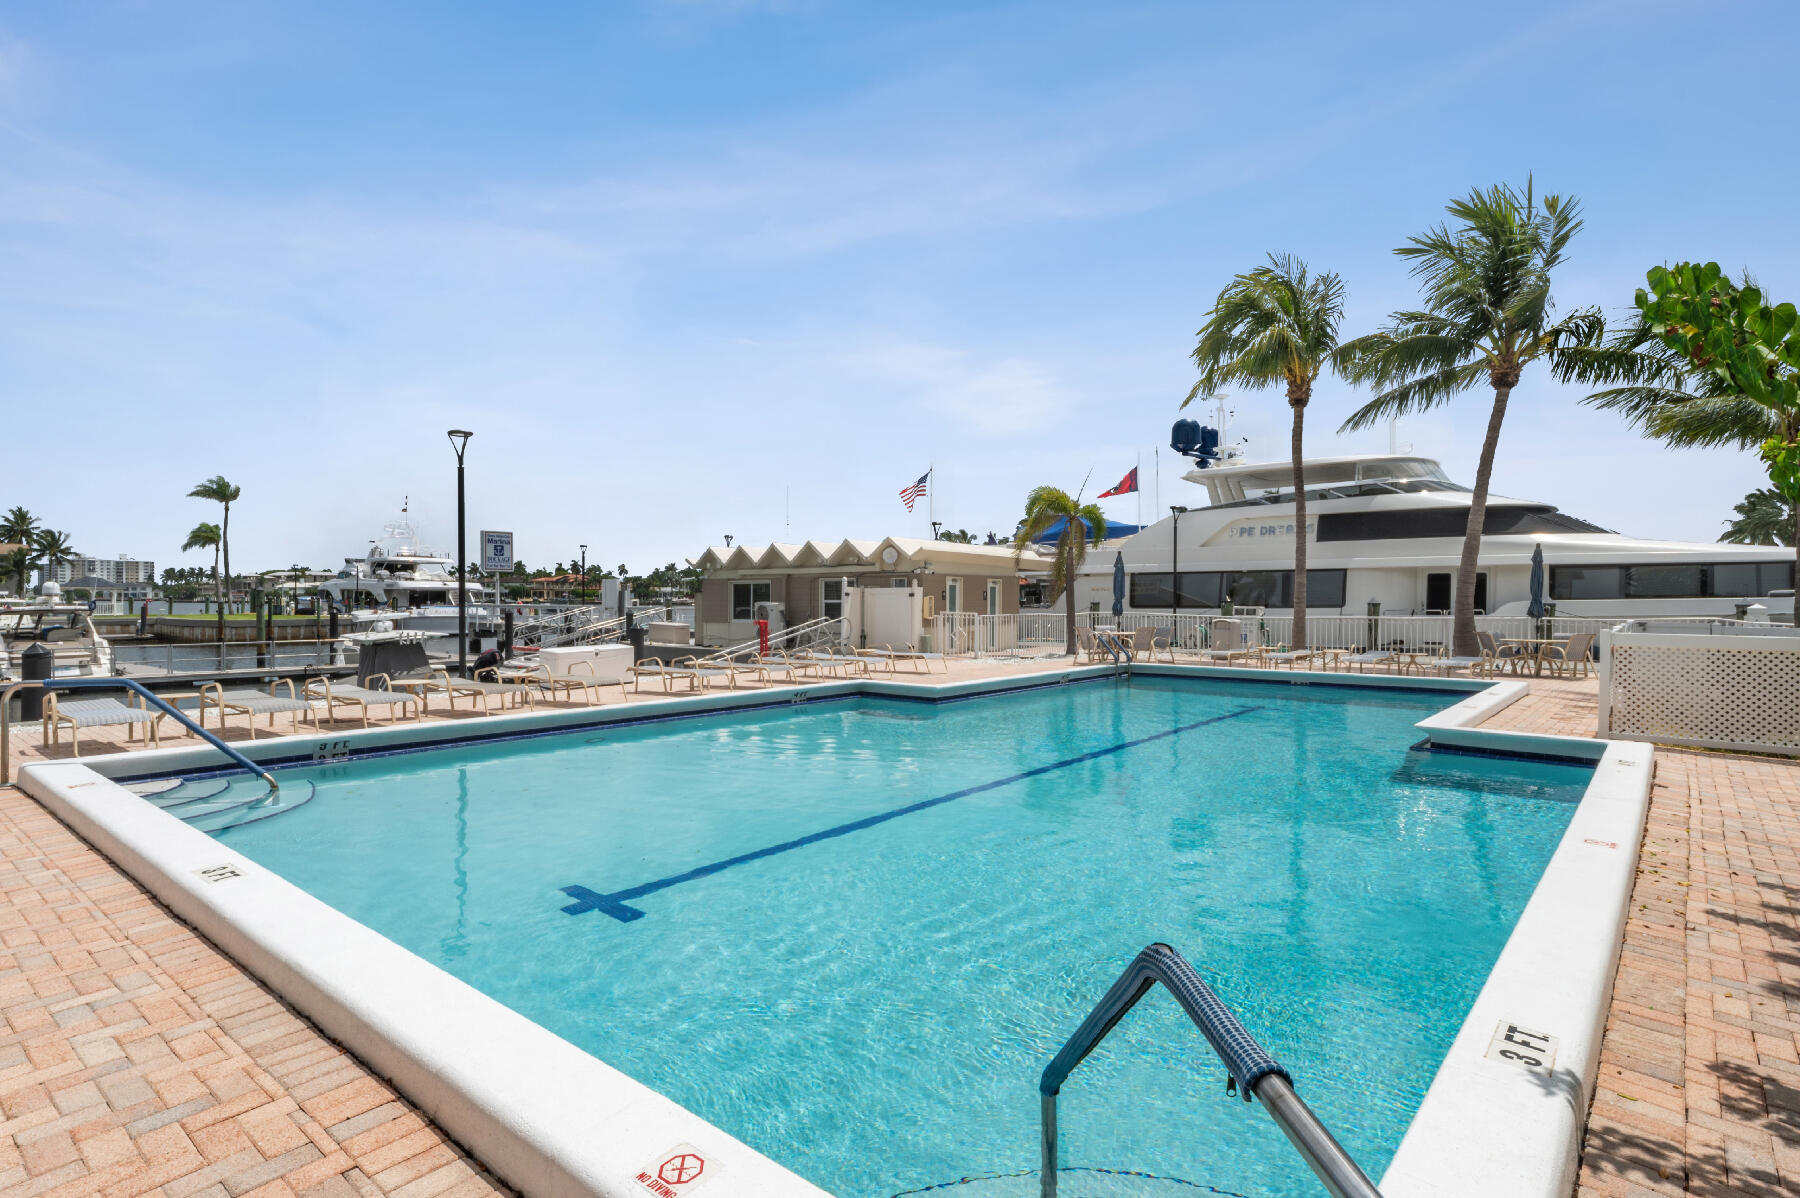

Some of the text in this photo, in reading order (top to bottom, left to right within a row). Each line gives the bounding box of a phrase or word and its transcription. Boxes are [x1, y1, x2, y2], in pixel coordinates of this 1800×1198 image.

[1260, 523, 1315, 537] DREAS
[487, 537, 511, 545] Marina
[1499, 1049, 1543, 1067] 3
[635, 1171, 652, 1183] NO
